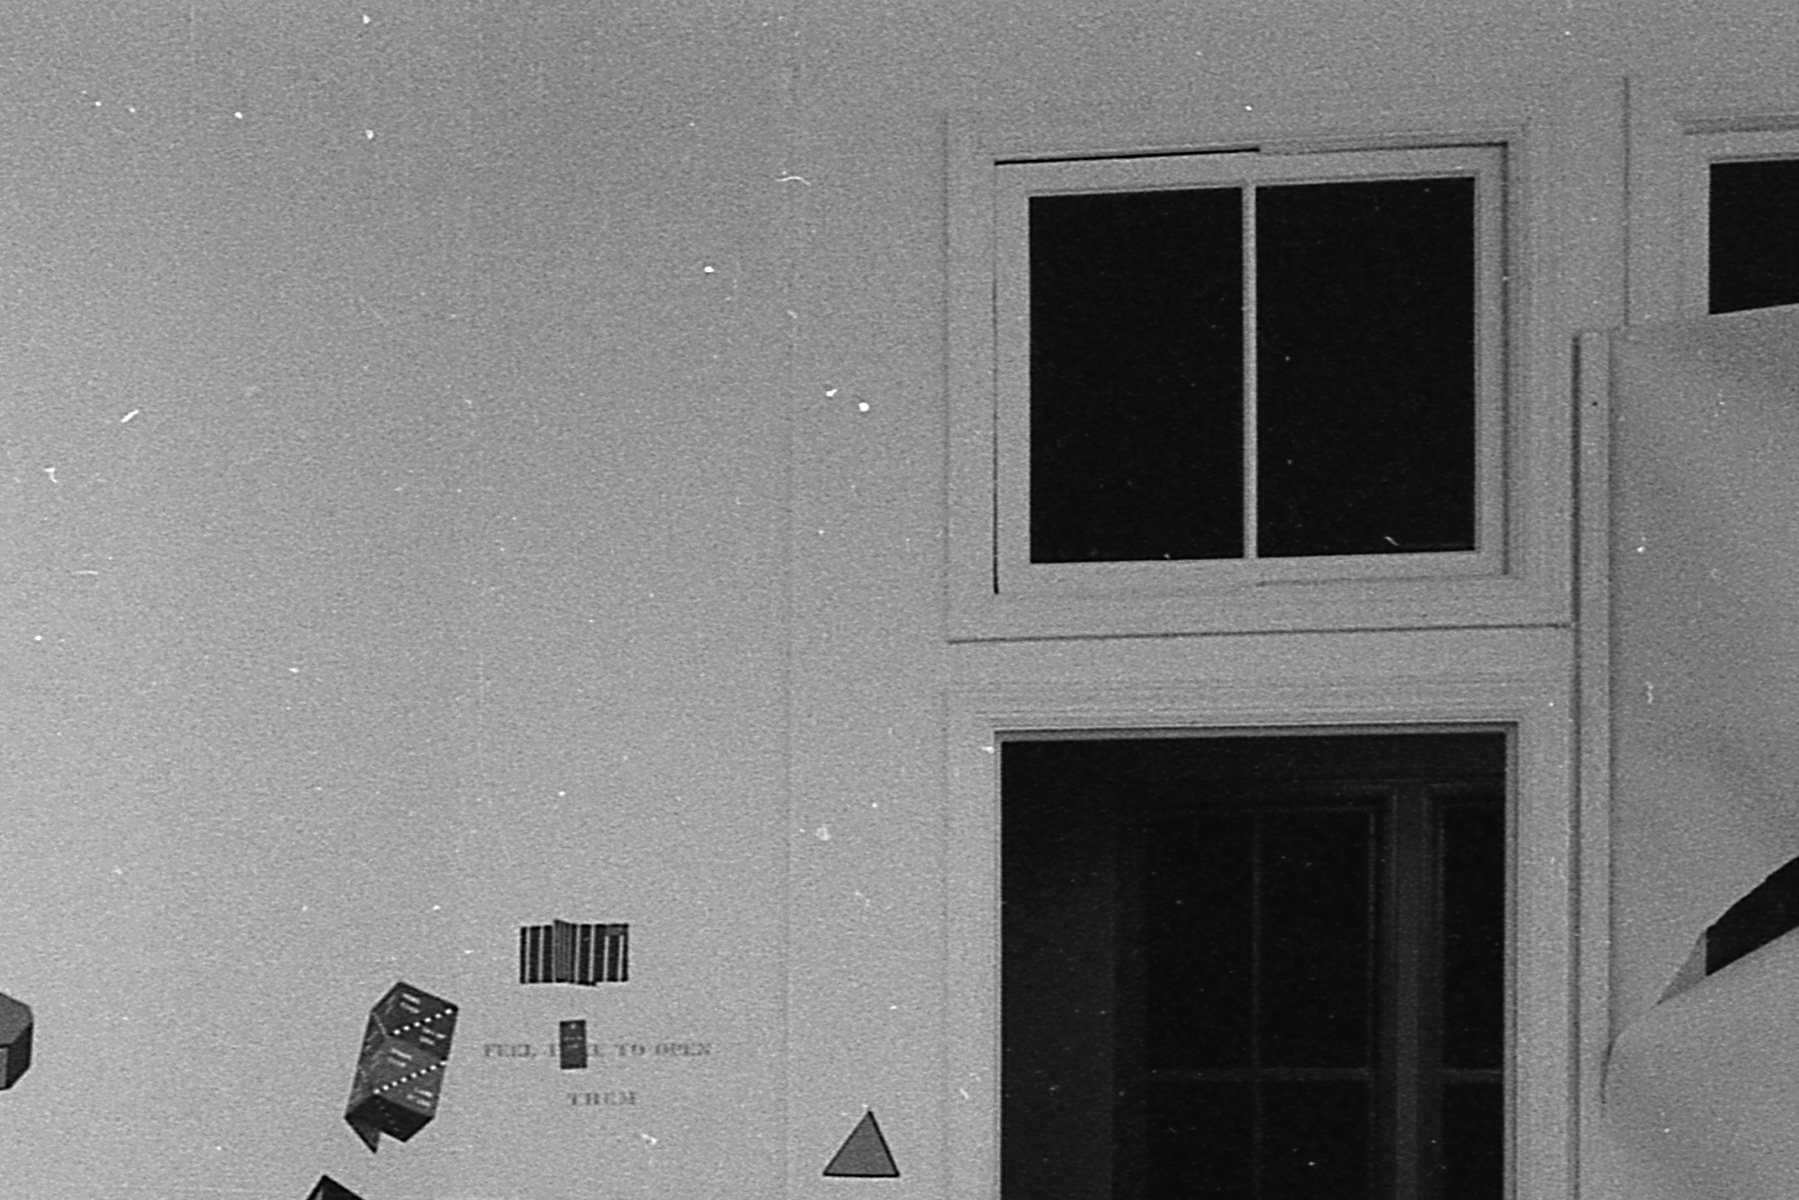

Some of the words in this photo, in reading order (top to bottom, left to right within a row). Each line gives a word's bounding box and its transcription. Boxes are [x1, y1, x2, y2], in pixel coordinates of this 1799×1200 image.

[614, 1043, 646, 1057] TO
[654, 1042, 712, 1057] OPEN
[567, 1090, 638, 1106] THEM
